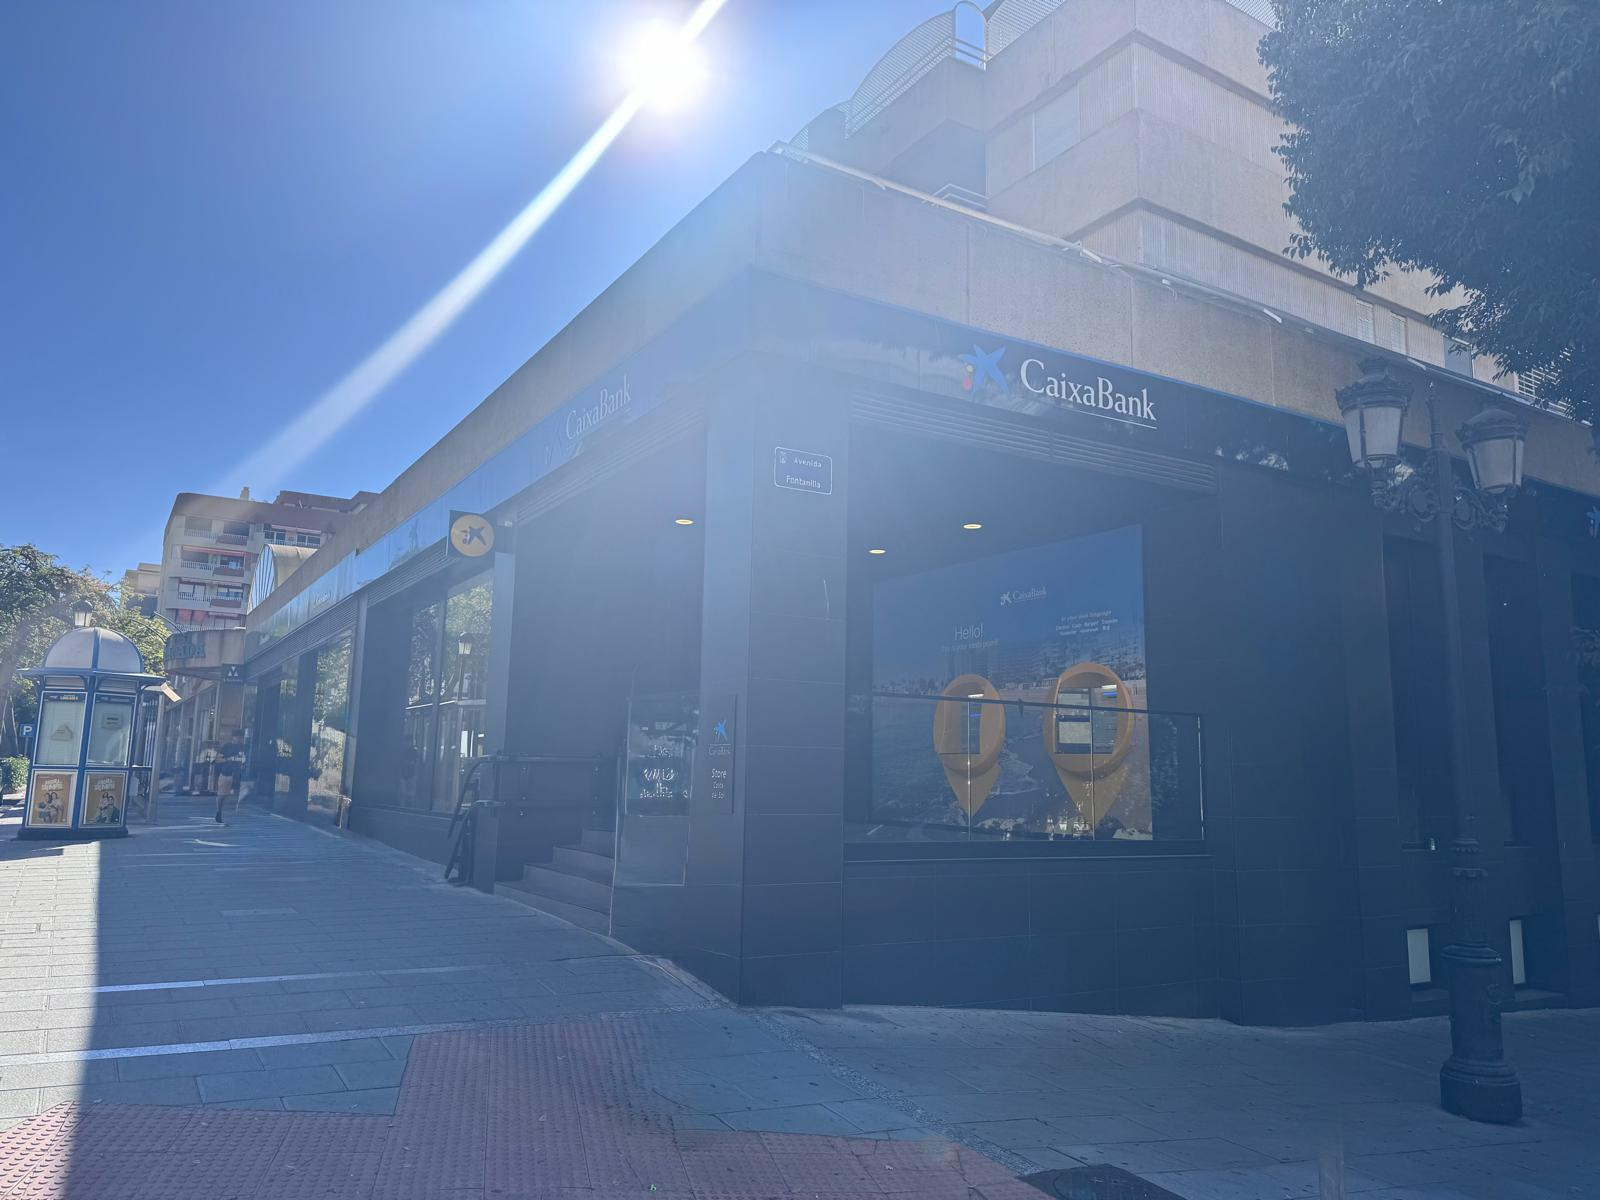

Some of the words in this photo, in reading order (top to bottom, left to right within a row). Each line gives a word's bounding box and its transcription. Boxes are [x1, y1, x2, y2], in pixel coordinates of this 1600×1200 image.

[1020, 358, 1157, 421] CaixaBank
[566, 374, 632, 440] CaixaBank
[794, 456, 822, 468] Avenida
[786, 475, 821, 488] Fontanilla
[954, 624, 984, 641] Hello!
[23, 725, 33, 735] P
